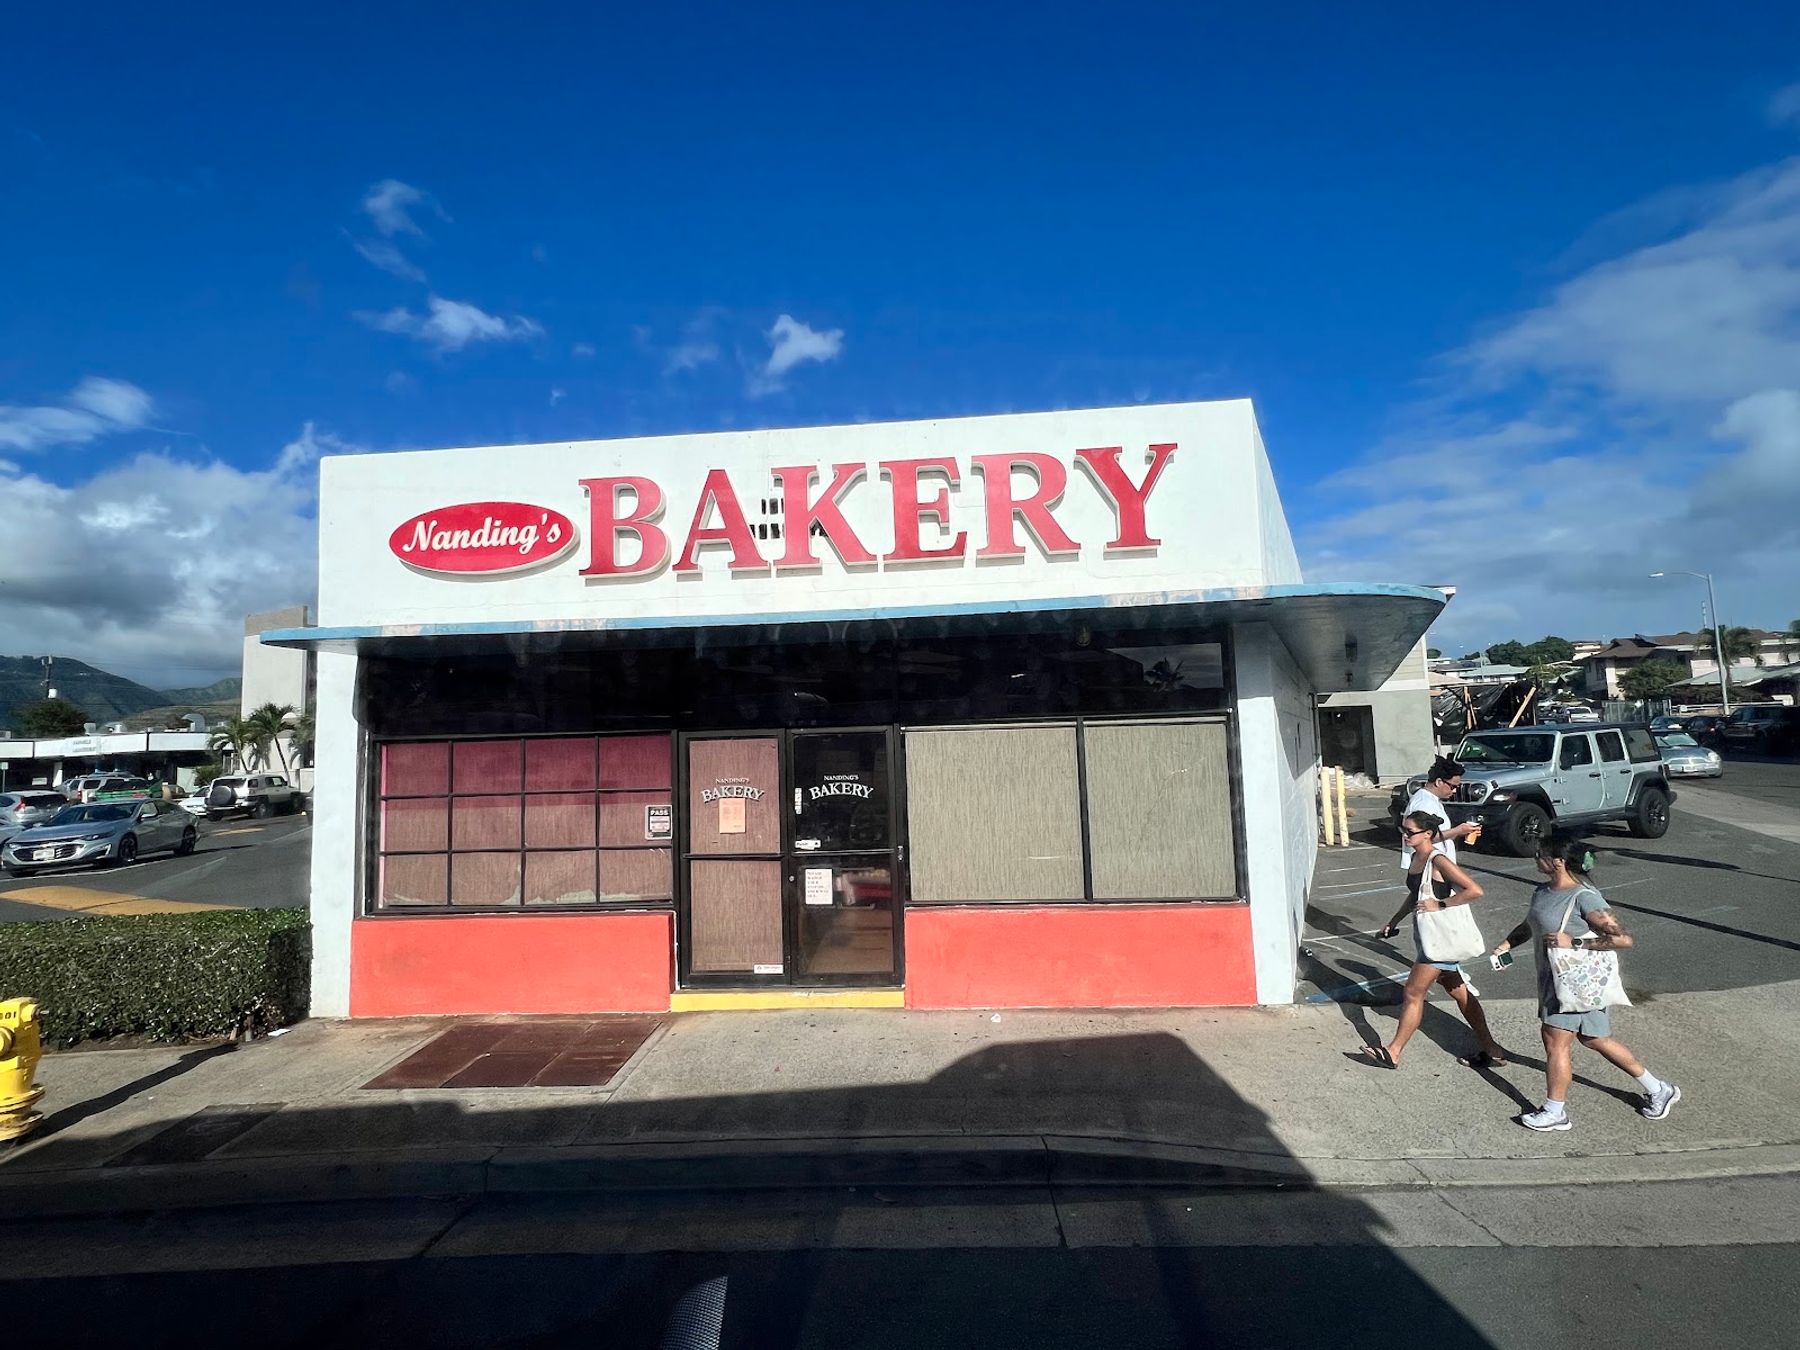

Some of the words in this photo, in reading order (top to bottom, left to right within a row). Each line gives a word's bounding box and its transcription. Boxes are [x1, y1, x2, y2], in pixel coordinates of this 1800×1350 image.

[402, 512, 562, 555] Nanding's
[578, 442, 1178, 579] BAKERY
[701, 785, 765, 802] BAKERY
[809, 782, 874, 800] BAKERY
